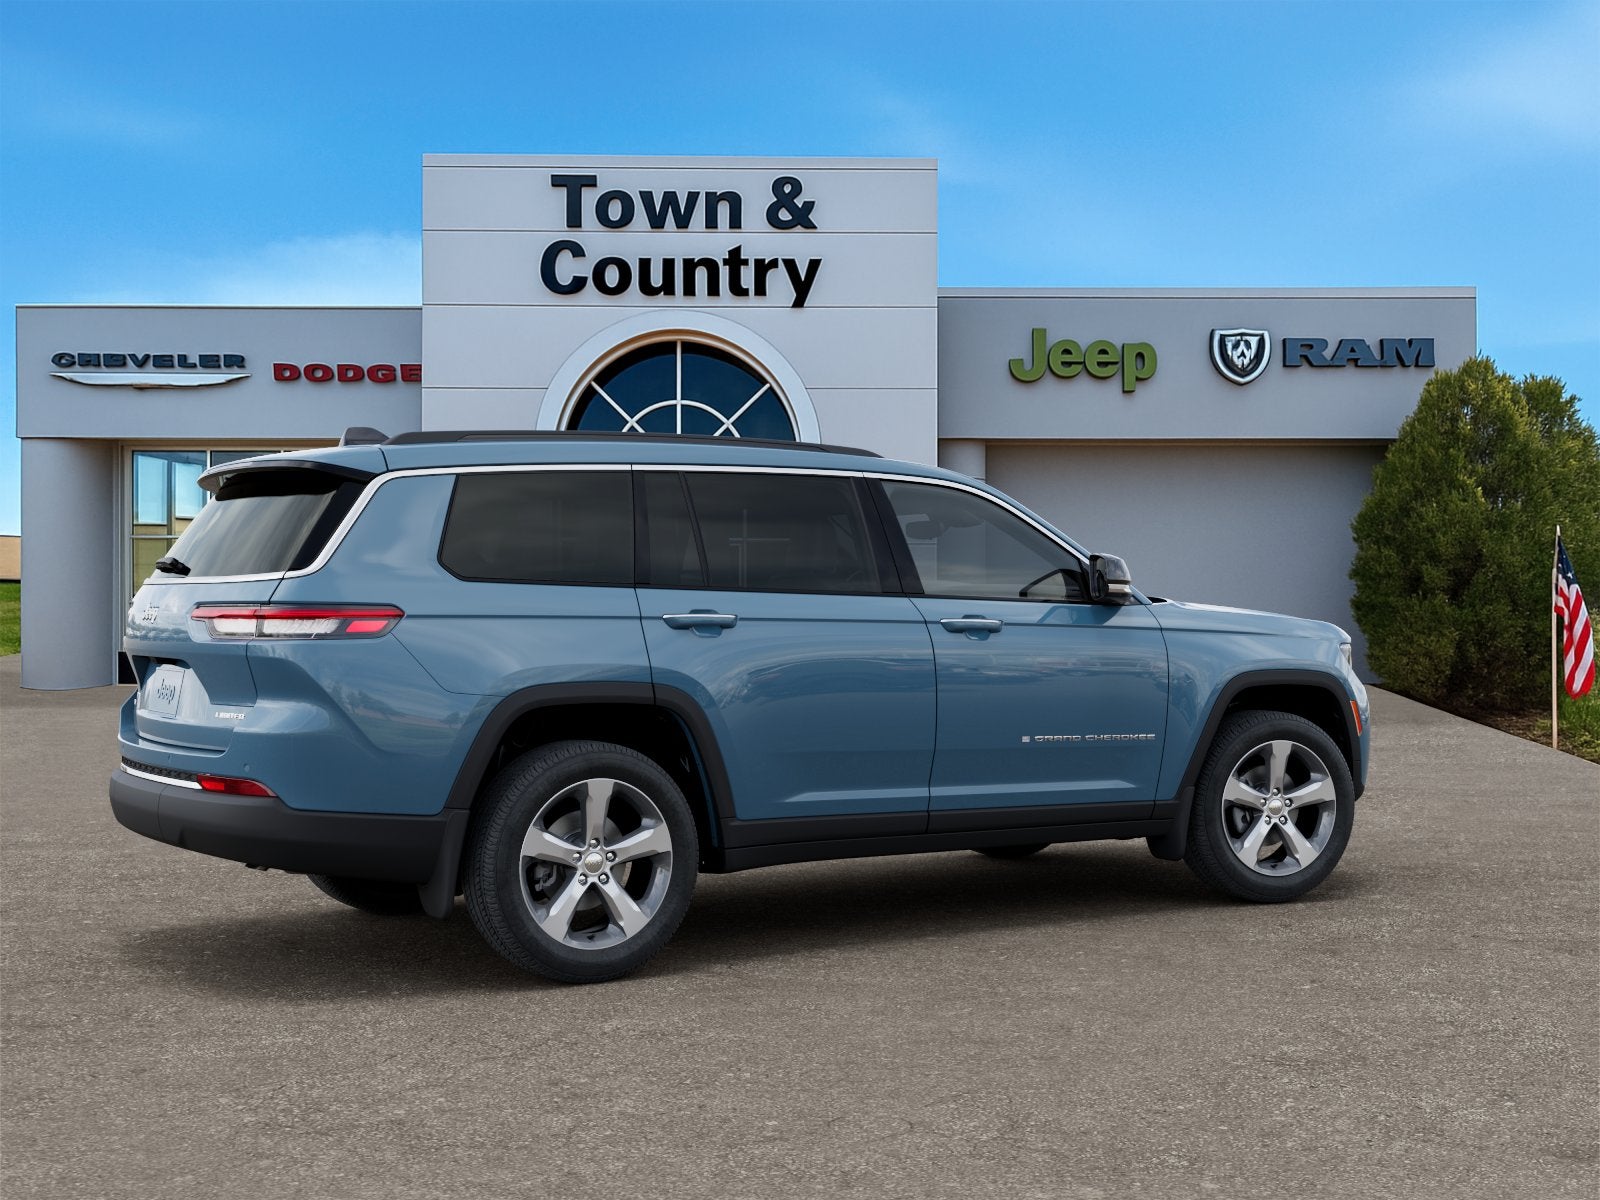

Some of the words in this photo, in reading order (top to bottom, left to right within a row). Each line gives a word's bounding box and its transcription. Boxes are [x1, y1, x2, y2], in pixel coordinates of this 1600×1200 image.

[550, 174, 743, 230] Town
[764, 175, 818, 230] &
[540, 239, 822, 308] Country
[272, 362, 422, 384] DODGE
[1009, 327, 1157, 393] Jeep
[1282, 337, 1435, 368] RAM
[1085, 733, 1156, 741] CHEROKEE
